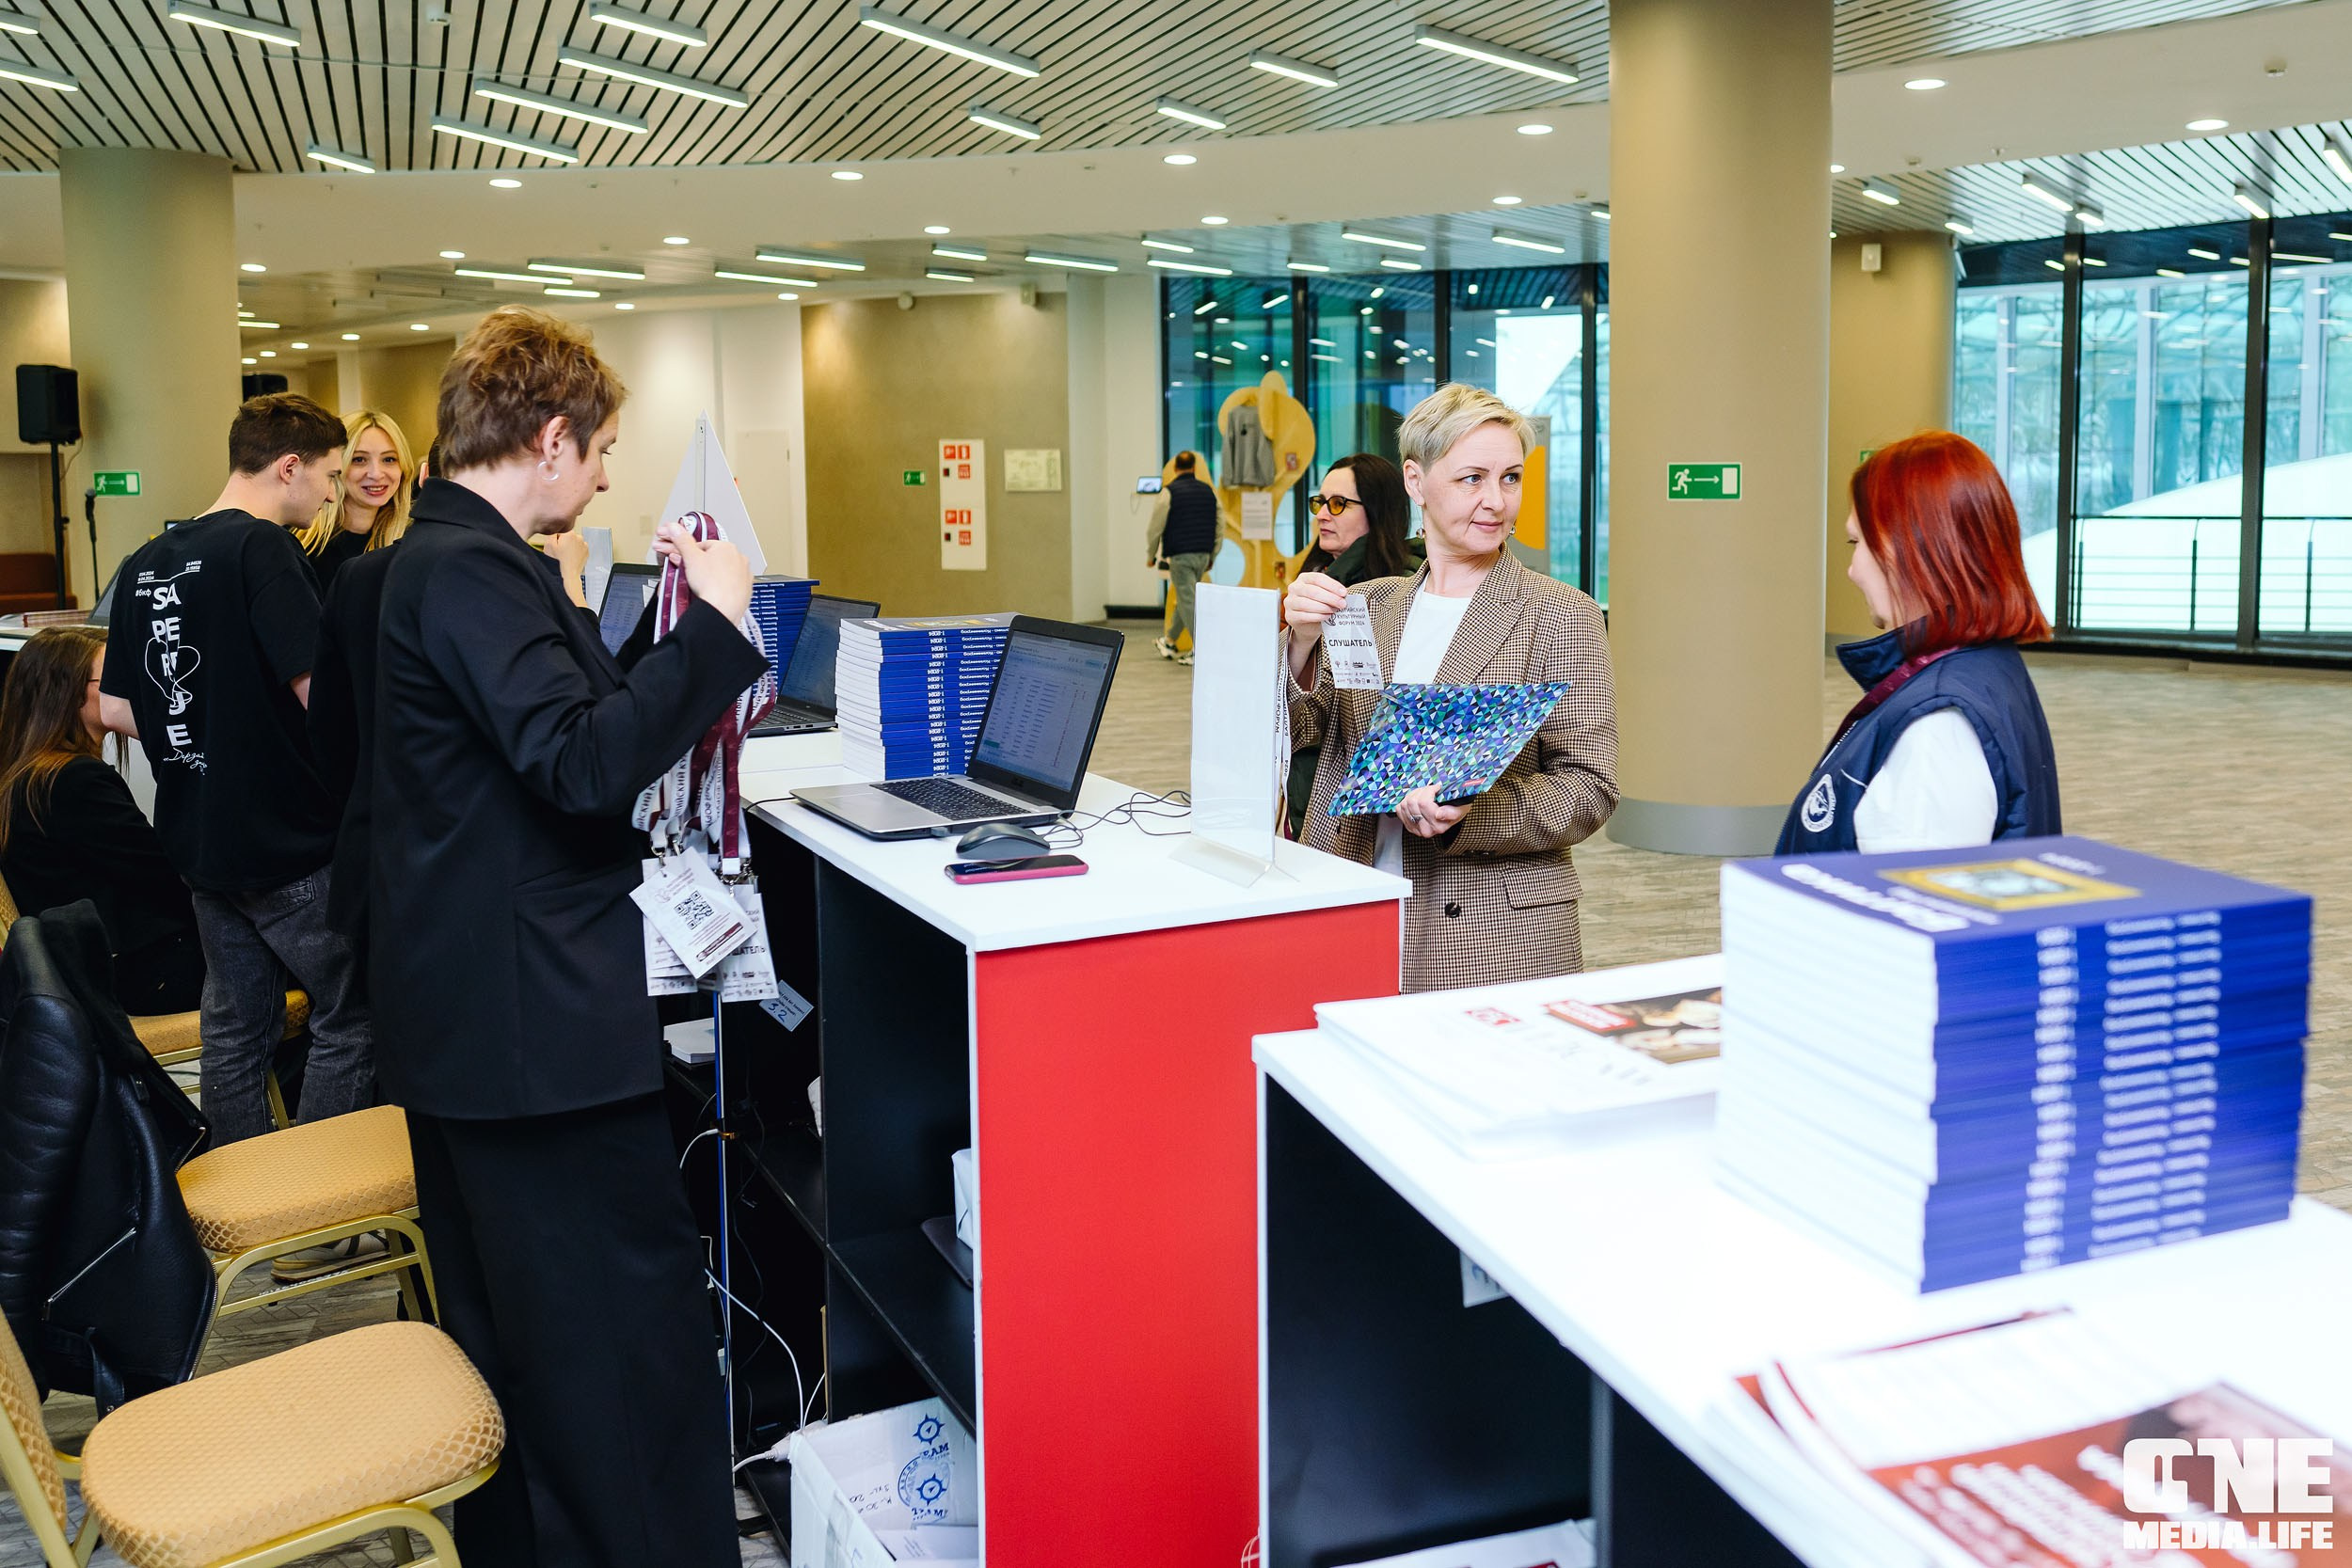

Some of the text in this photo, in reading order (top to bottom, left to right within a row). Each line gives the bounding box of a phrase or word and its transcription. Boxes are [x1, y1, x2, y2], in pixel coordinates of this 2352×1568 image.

[152, 583, 182, 610] SA
[151, 617, 182, 643] PE
[166, 723, 192, 747] E
[725, 944, 766, 957] ШАТЕЛЬ
